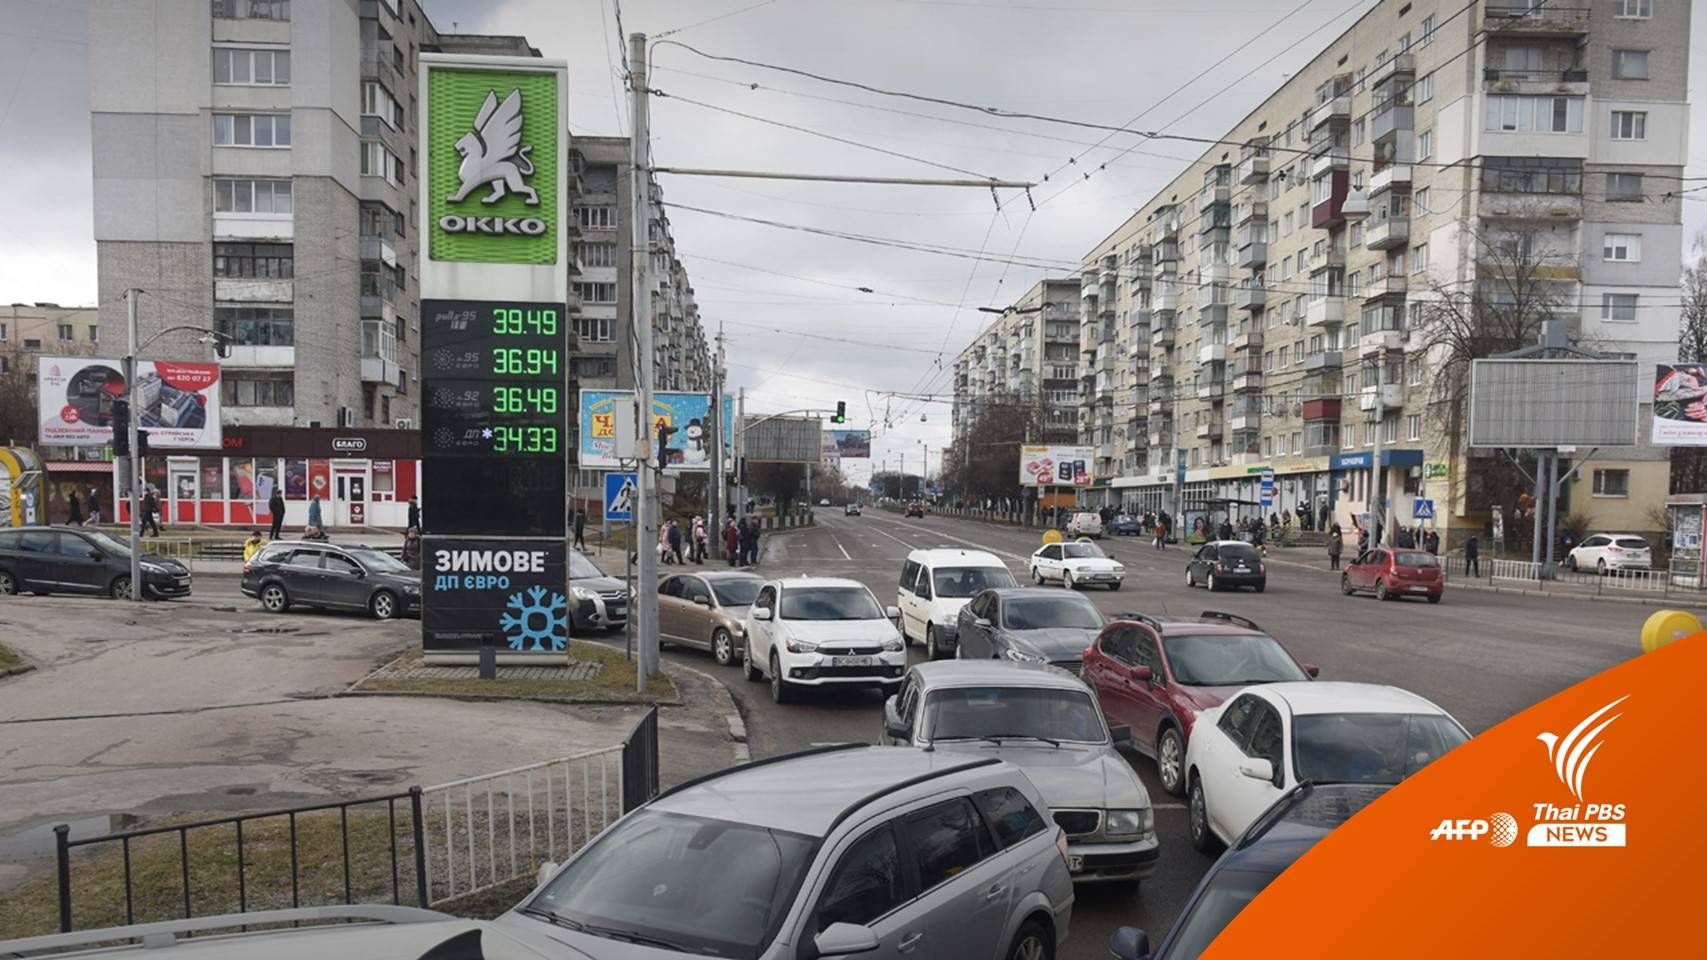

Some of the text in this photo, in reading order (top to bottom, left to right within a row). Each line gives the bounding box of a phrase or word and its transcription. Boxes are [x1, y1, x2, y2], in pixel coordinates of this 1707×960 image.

[439, 215, 546, 235] OKKO
[493, 309, 557, 335] 39.49
[493, 348, 557, 374] 36.94
[493, 387, 557, 413] 36.49
[336, 440, 364, 448] БЛАГО
[494, 426, 557, 452] 34.33
[434, 549, 545, 573] ЗИМОВЕ
[434, 575, 510, 591] ДП ЄВРО
